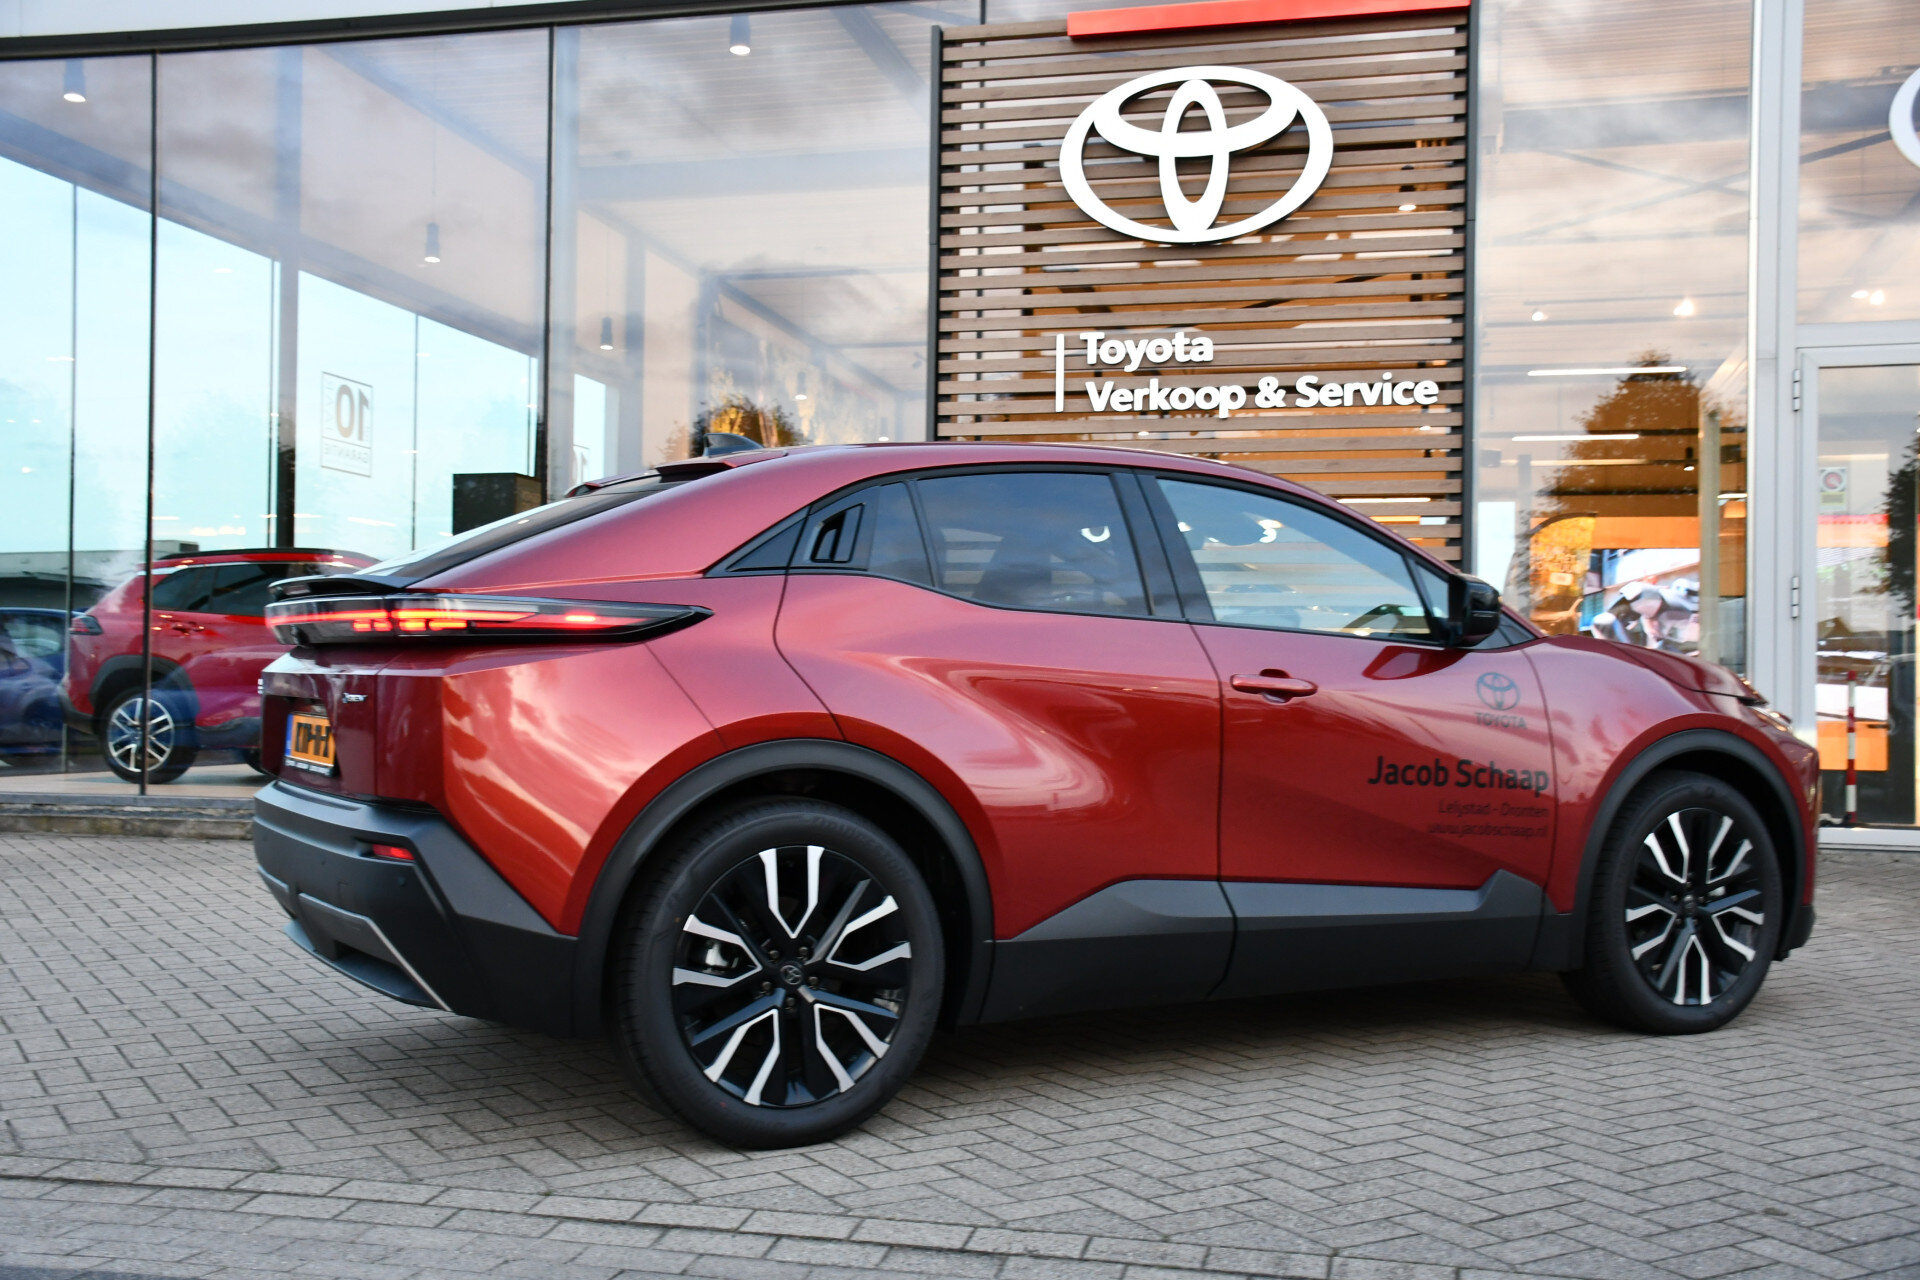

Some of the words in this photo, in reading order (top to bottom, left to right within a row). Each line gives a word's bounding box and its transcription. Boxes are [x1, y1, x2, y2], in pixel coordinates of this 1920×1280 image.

[1079, 331, 1214, 372] Toyota
[1085, 378, 1247, 419] Verkoop
[1254, 376, 1287, 409] &
[1295, 371, 1440, 408] Service
[1475, 711, 1528, 730] TOYOTA
[1368, 756, 1448, 787] Jacob
[1454, 759, 1549, 798] Schaap
[1501, 803, 1549, 818] Dronten
[1428, 823, 1549, 840] www.jacobschaap.nl
